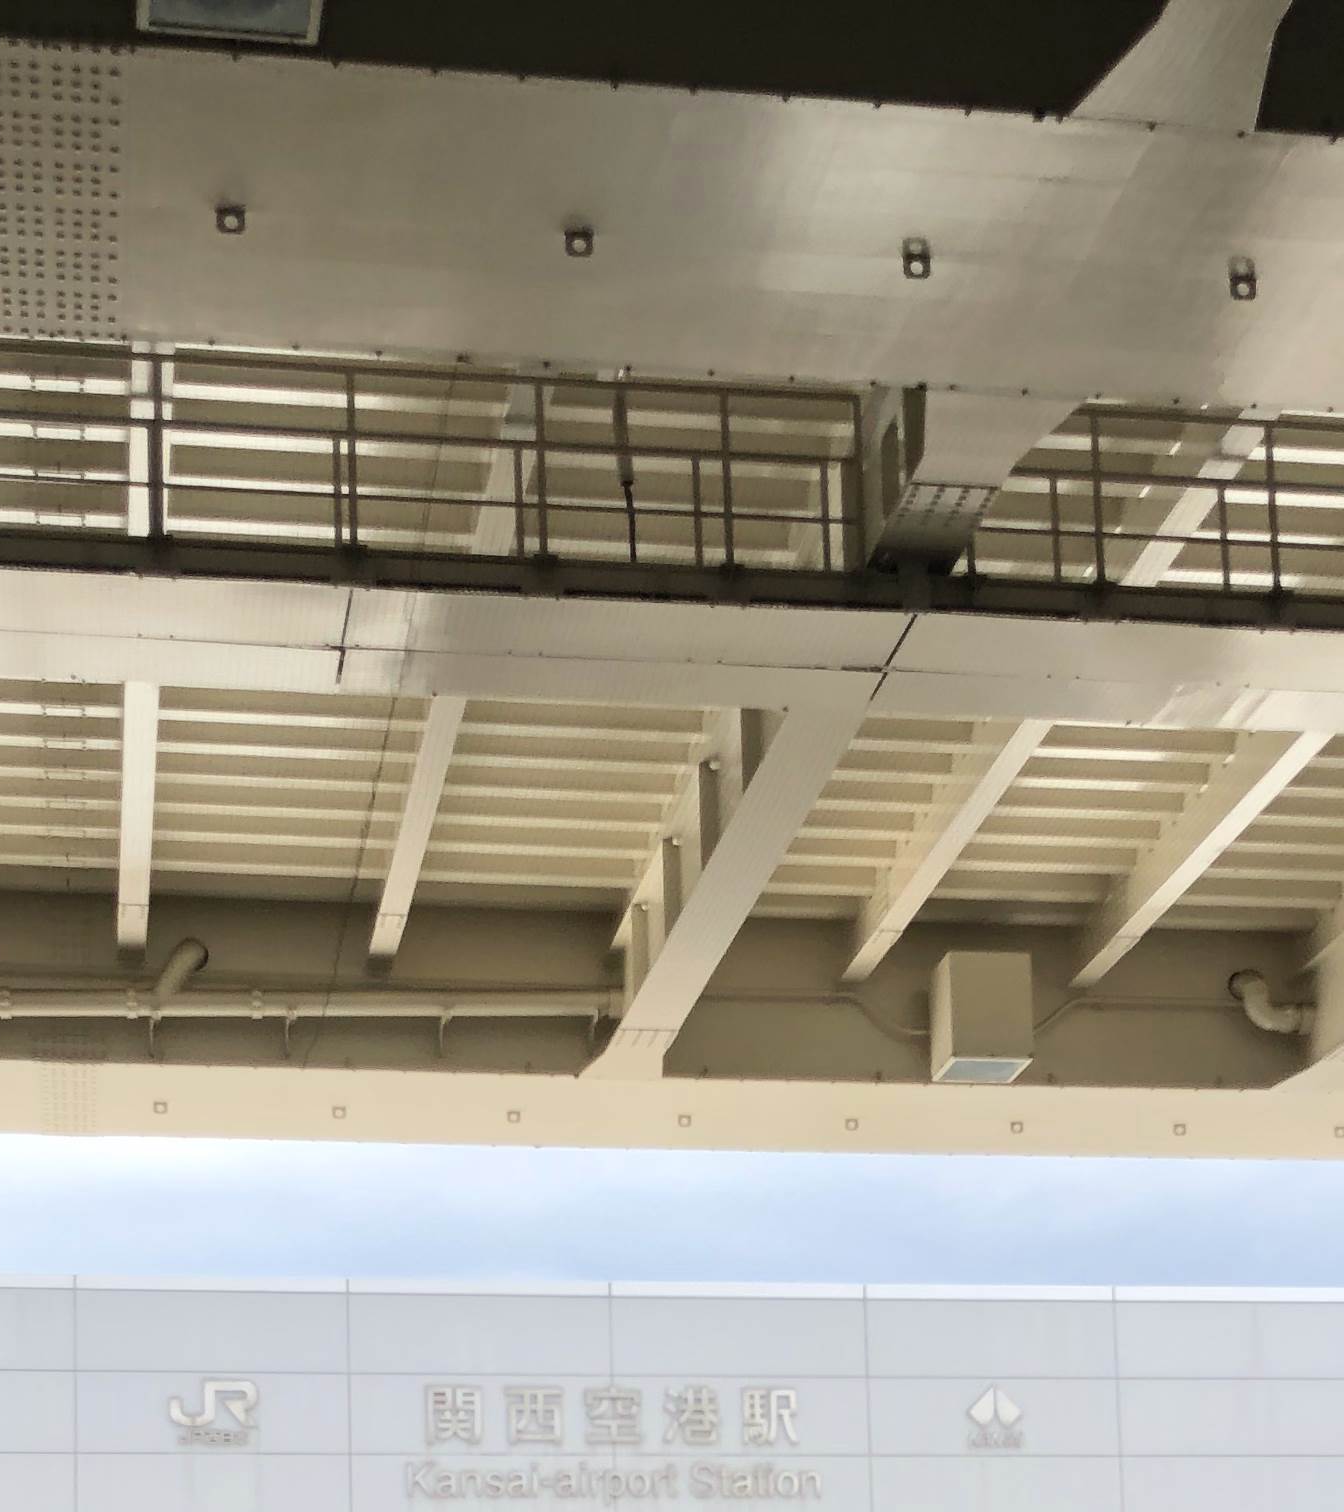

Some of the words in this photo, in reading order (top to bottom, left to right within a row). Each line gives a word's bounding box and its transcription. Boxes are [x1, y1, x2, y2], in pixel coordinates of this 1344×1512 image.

[167, 1379, 259, 1427] JR
[424, 1383, 800, 1446] 関西空港駅
[405, 1460, 679, 1506] Kansai-airport
[690, 1461, 823, 1501] Station
